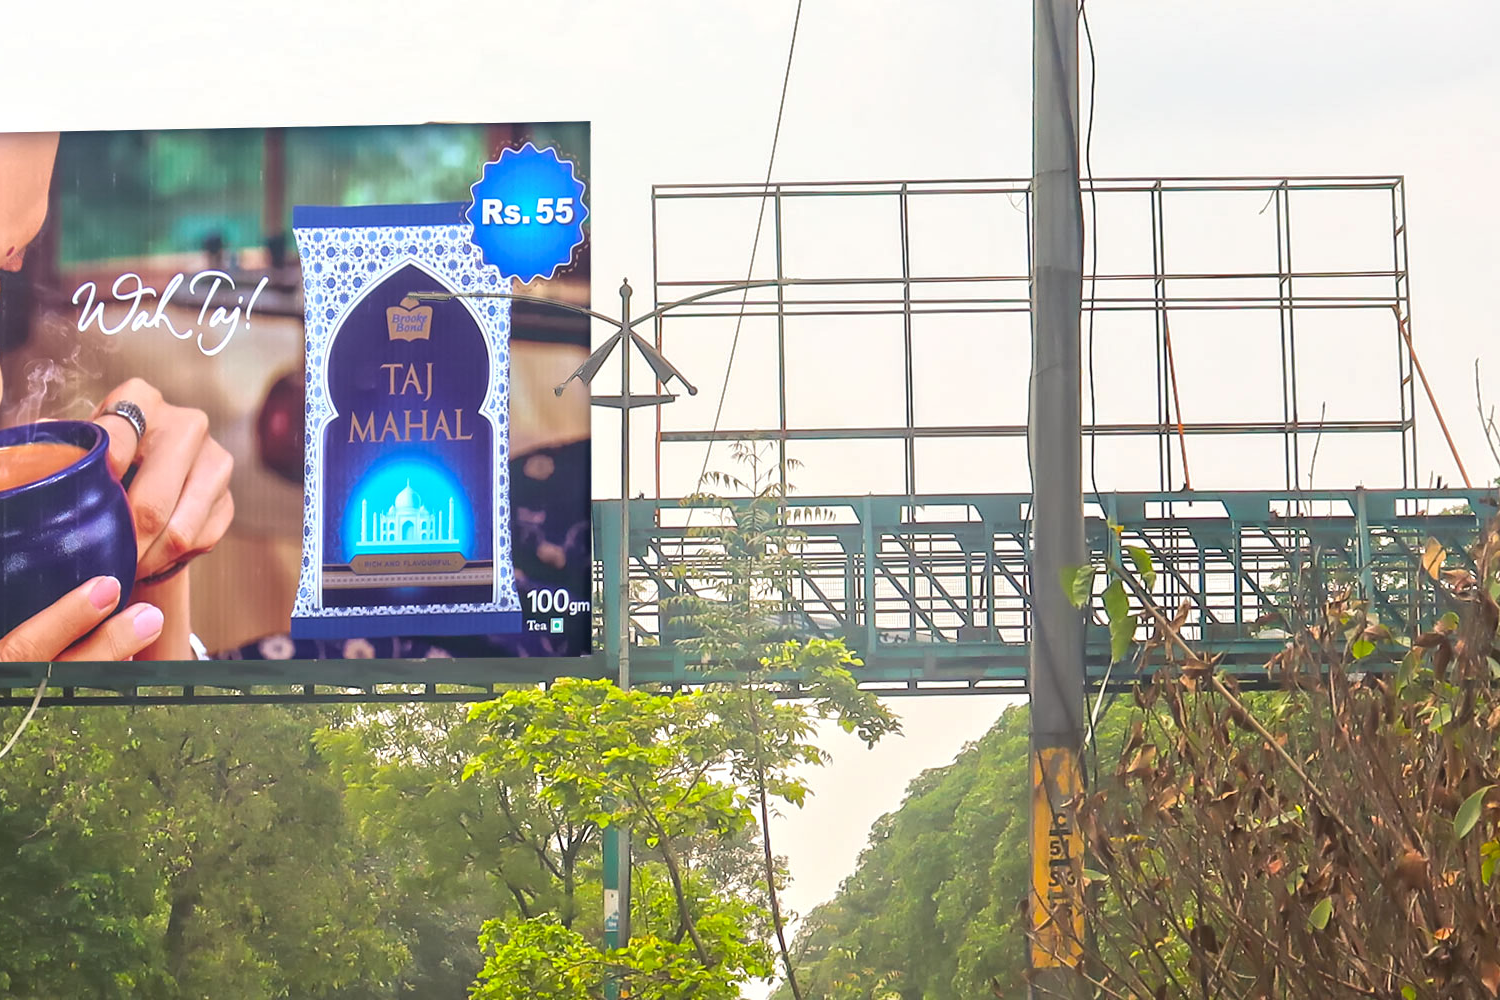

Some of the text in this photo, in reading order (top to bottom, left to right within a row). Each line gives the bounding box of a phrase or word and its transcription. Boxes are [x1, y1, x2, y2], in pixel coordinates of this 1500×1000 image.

[481, 197, 574, 225] Rs. 55
[71, 269, 269, 357] Wah Taj!
[392, 312, 428, 324] Brooke
[396, 322, 424, 332] Bond
[380, 362, 434, 402] TAJ
[348, 408, 474, 443] MAHAL
[364, 560, 382, 568] RICH
[526, 619, 548, 631] Tea
